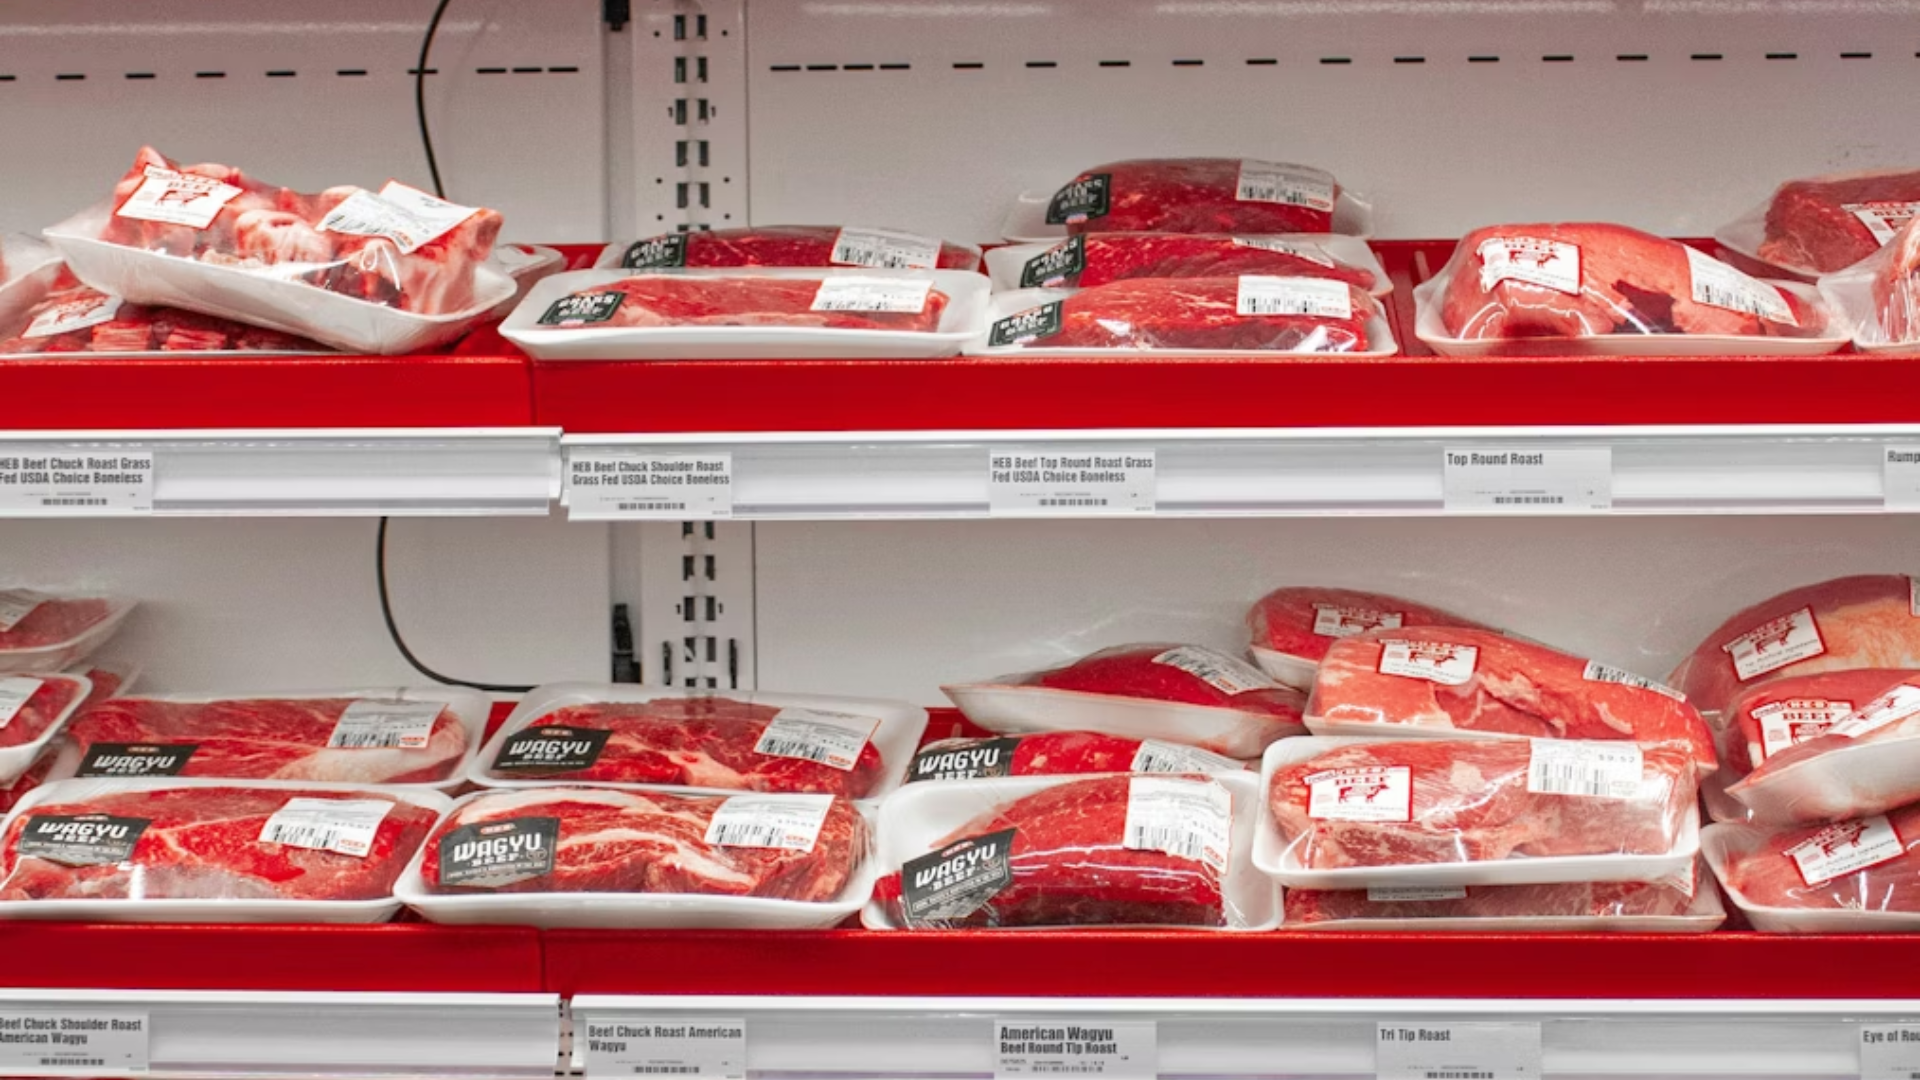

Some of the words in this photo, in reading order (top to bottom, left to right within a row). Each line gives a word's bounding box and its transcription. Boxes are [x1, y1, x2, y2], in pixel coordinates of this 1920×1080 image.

[22, 457, 47, 470] Beef
[50, 457, 84, 470] Chuck
[86, 457, 118, 470] Roast
[120, 457, 151, 470] Grass
[992, 457, 1012, 468] HEB
[1015, 457, 1038, 468] Beef
[1040, 457, 1058, 469] Top
[1060, 457, 1092, 468] Round
[1094, 457, 1122, 468] Roast
[1125, 457, 1153, 469] Grass
[1447, 453, 1468, 466] Top
[1471, 453, 1508, 465] Round
[1510, 453, 1543, 466] Roast
[572, 461, 591, 472] HEB
[594, 461, 616, 472] Beef
[618, 461, 648, 472] Chuck
[651, 461, 694, 472] Shoulder
[696, 461, 724, 472] Roast
[20, 472, 50, 484] USDA
[52, 472, 90, 484] Choice
[93, 472, 143, 484] Boneless
[572, 475, 599, 485] Grass
[602, 474, 619, 485] Fed
[621, 474, 648, 485] USDA
[650, 474, 683, 485] Choice
[686, 474, 730, 485] Boneless
[992, 471, 1010, 482] Fed
[1012, 471, 1040, 482] USDA
[1042, 471, 1077, 482] Choice
[1079, 471, 1125, 482] Boneless
[506, 740, 592, 756] WAGYU
[92, 755, 176, 769] WAGYU
[918, 748, 1000, 774] WAGYU
[37, 822, 129, 839] WAGYU
[453, 833, 542, 862] WAGYU
[915, 843, 997, 888] WAGYU
[24, 1017, 58, 1030] Chuck
[60, 1017, 109, 1030] Shoulder
[111, 1018, 142, 1031] Roast
[588, 1025, 614, 1037] Beef
[617, 1025, 651, 1038] Chuck
[654, 1026, 686, 1038] Roast
[688, 1026, 742, 1038] American
[1000, 1026, 1065, 1041] American
[1067, 1026, 1113, 1042] Wagyu
[1380, 1028, 1395, 1041] Tri
[1398, 1028, 1415, 1042] Tip
[1418, 1028, 1451, 1041] Roast
[1863, 1030, 1884, 1043] Eye
[1887, 1030, 1898, 1042] of
[51, 1032, 88, 1045] Wagyu
[588, 1040, 627, 1053] Wagyu
[1000, 1042, 1026, 1055] Beef
[1028, 1042, 1064, 1055] Round
[1066, 1042, 1083, 1056] Tip
[1085, 1042, 1118, 1055] Roast
